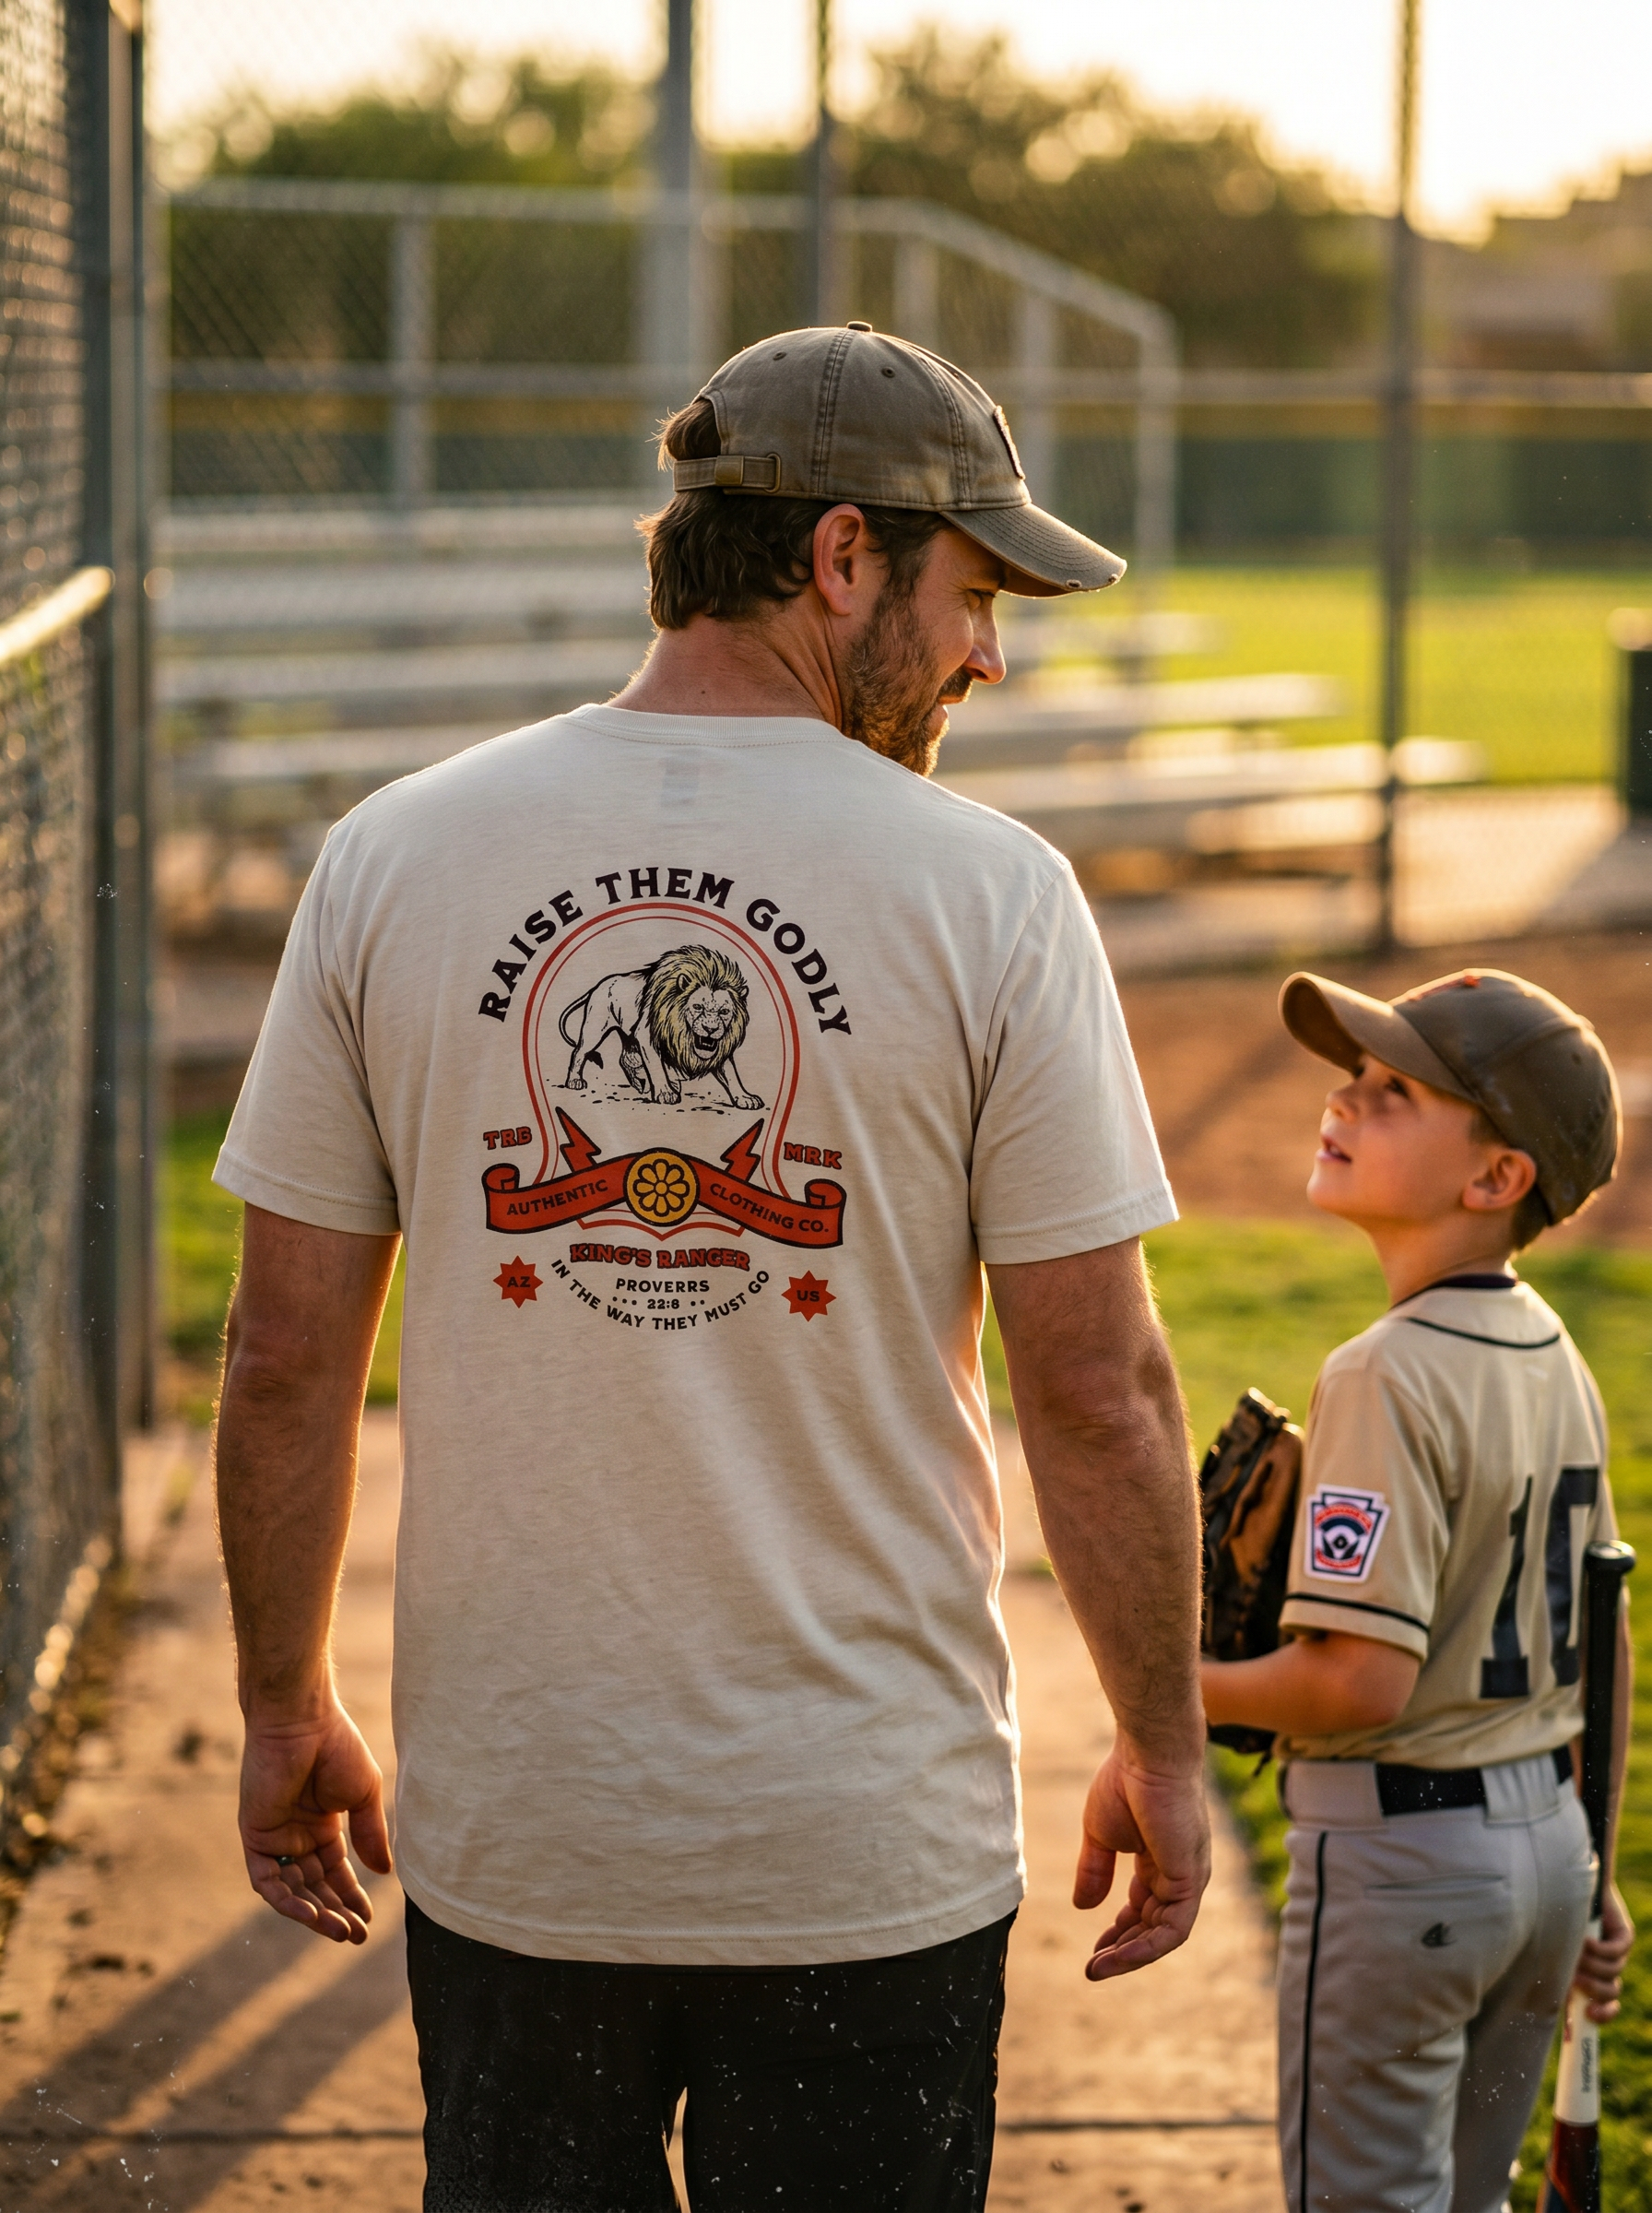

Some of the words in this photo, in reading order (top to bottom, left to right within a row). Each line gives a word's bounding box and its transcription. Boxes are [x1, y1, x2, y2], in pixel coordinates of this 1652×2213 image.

[478, 889, 584, 1023] RAISE
[596, 867, 735, 910] THEM
[745, 898, 852, 1035] GODLY
[784, 1142, 843, 1170] MRK
[506, 1179, 608, 1215] AUTHENTIC
[710, 1183, 794, 1229] CLOTHING
[798, 1219, 830, 1233] CO.
[570, 1243, 652, 1268] KING'S
[656, 1247, 750, 1272] RANGER
[507, 1276, 531, 1288] AZ
[550, 1259, 571, 1279] IN
[569, 1279, 601, 1309] THE
[607, 1305, 645, 1328] WAY
[652, 1314, 698, 1331] THEY
[704, 1292, 748, 1323] MUST
[748, 1270, 770, 1295] GO
[615, 1278, 710, 1293] PROVERRS
[796, 1289, 820, 1302] US
[647, 1298, 680, 1309] 22:8
